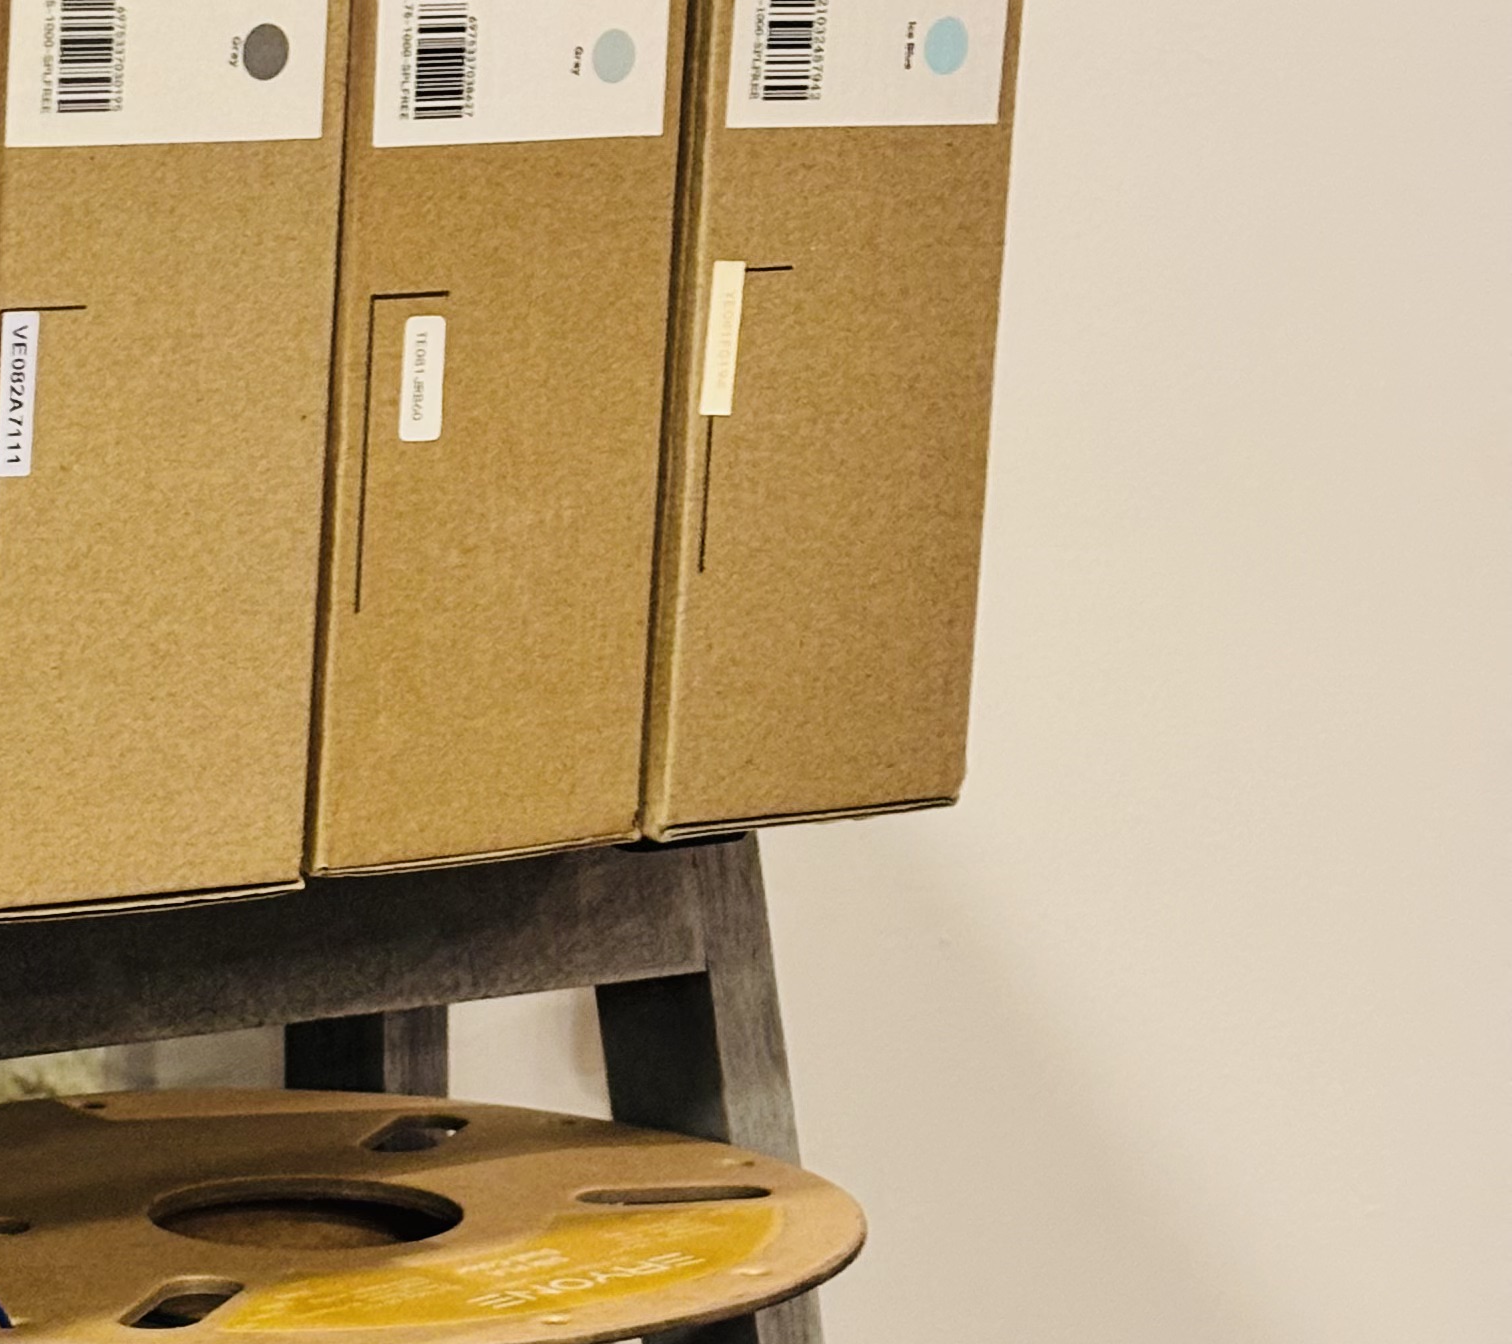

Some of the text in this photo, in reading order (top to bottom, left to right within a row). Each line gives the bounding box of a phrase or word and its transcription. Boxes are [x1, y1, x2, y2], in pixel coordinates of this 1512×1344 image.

[228, 36, 242, 67] Gray
[570, 46, 583, 75] Gray
[7, 326, 27, 462] VE082A7111
